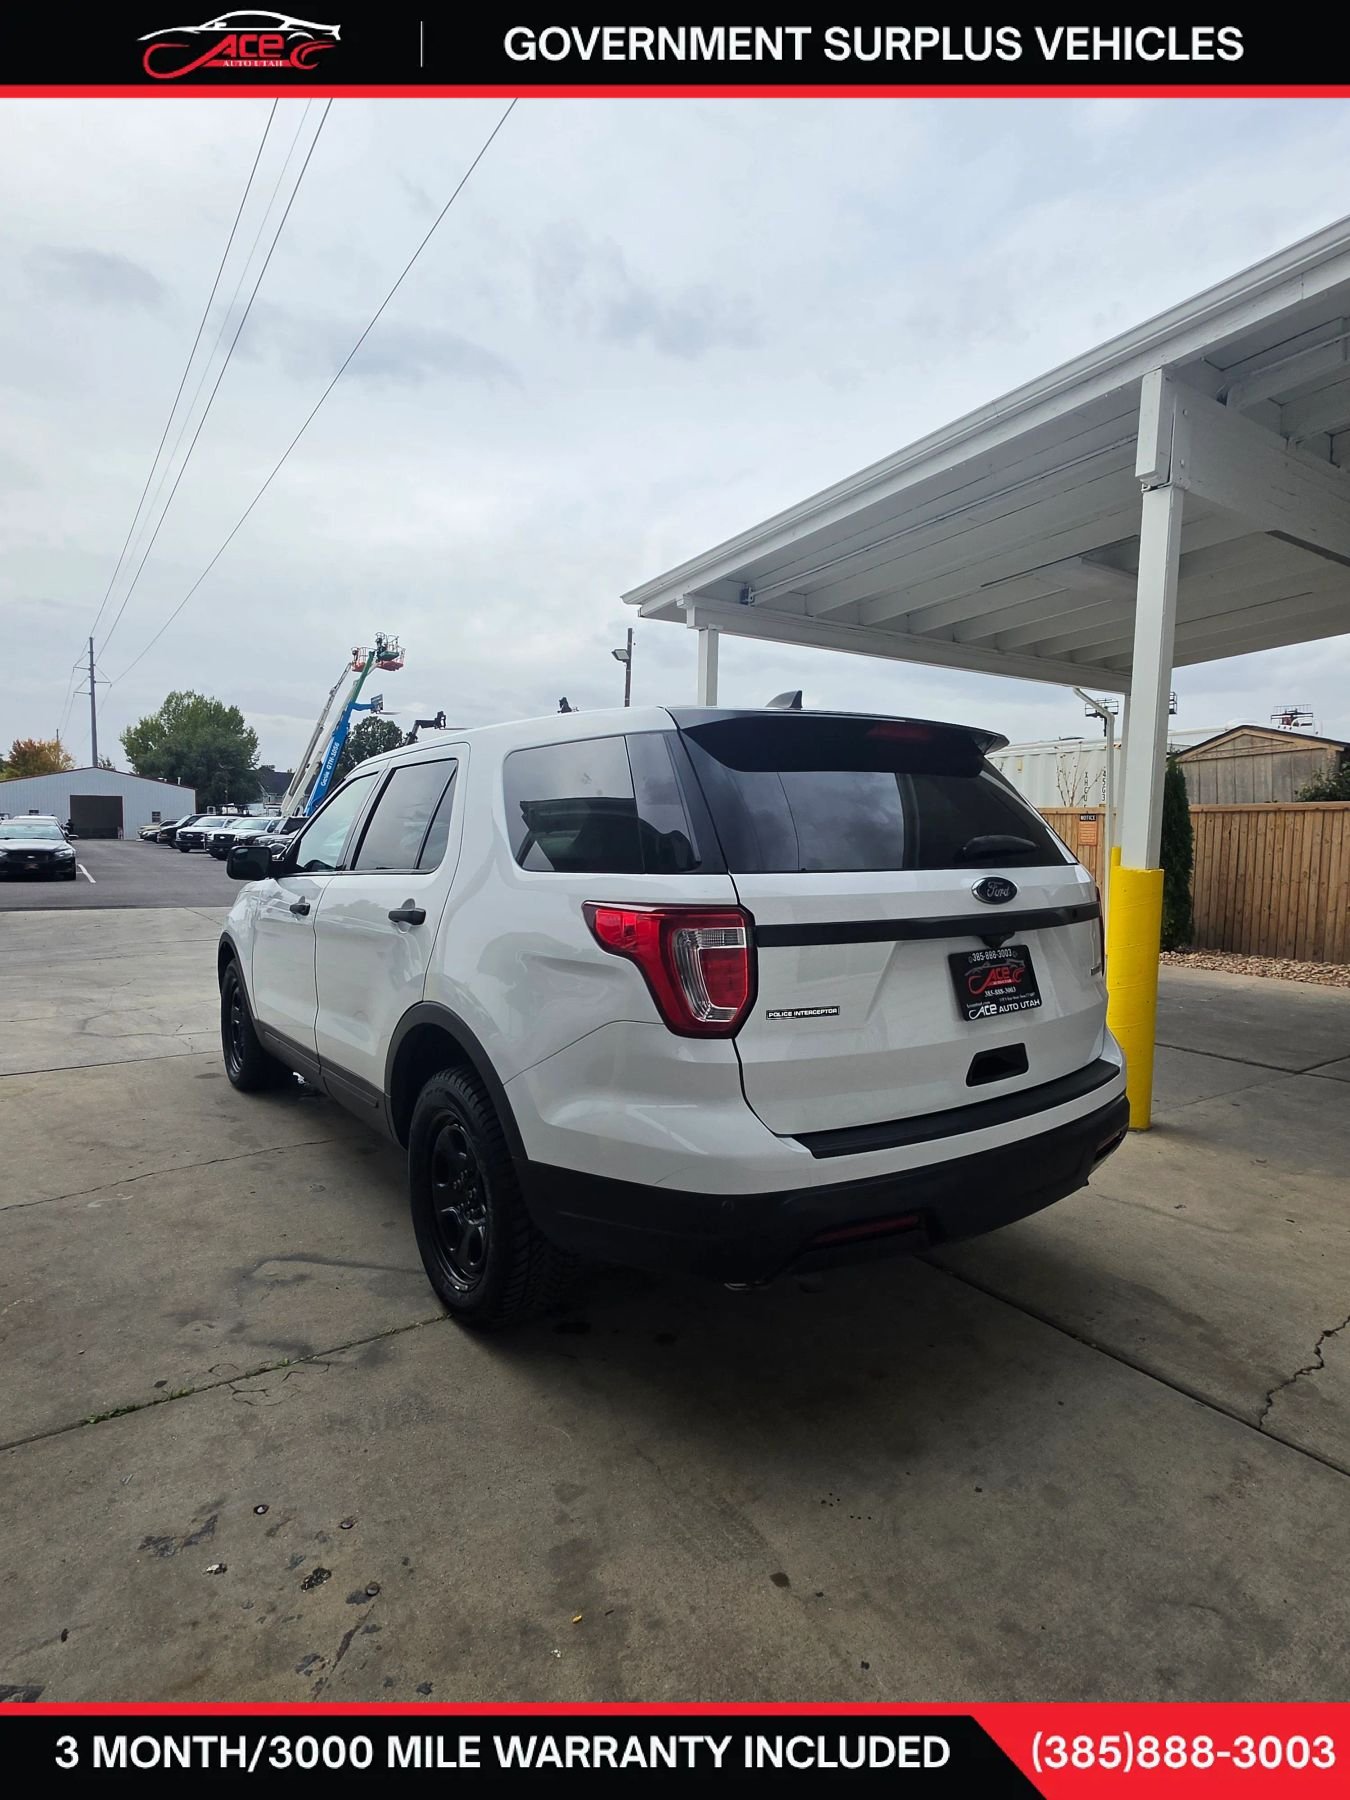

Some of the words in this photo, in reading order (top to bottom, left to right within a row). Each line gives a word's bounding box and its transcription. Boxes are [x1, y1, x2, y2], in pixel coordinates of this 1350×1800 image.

[986, 881, 1010, 898] Ford
[971, 948, 1013, 962] 385-888-3003
[793, 1008, 838, 1016] INTERCEPTOR
[998, 1002, 1019, 1013] AUTO
[1019, 998, 1041, 1009] UTAH
